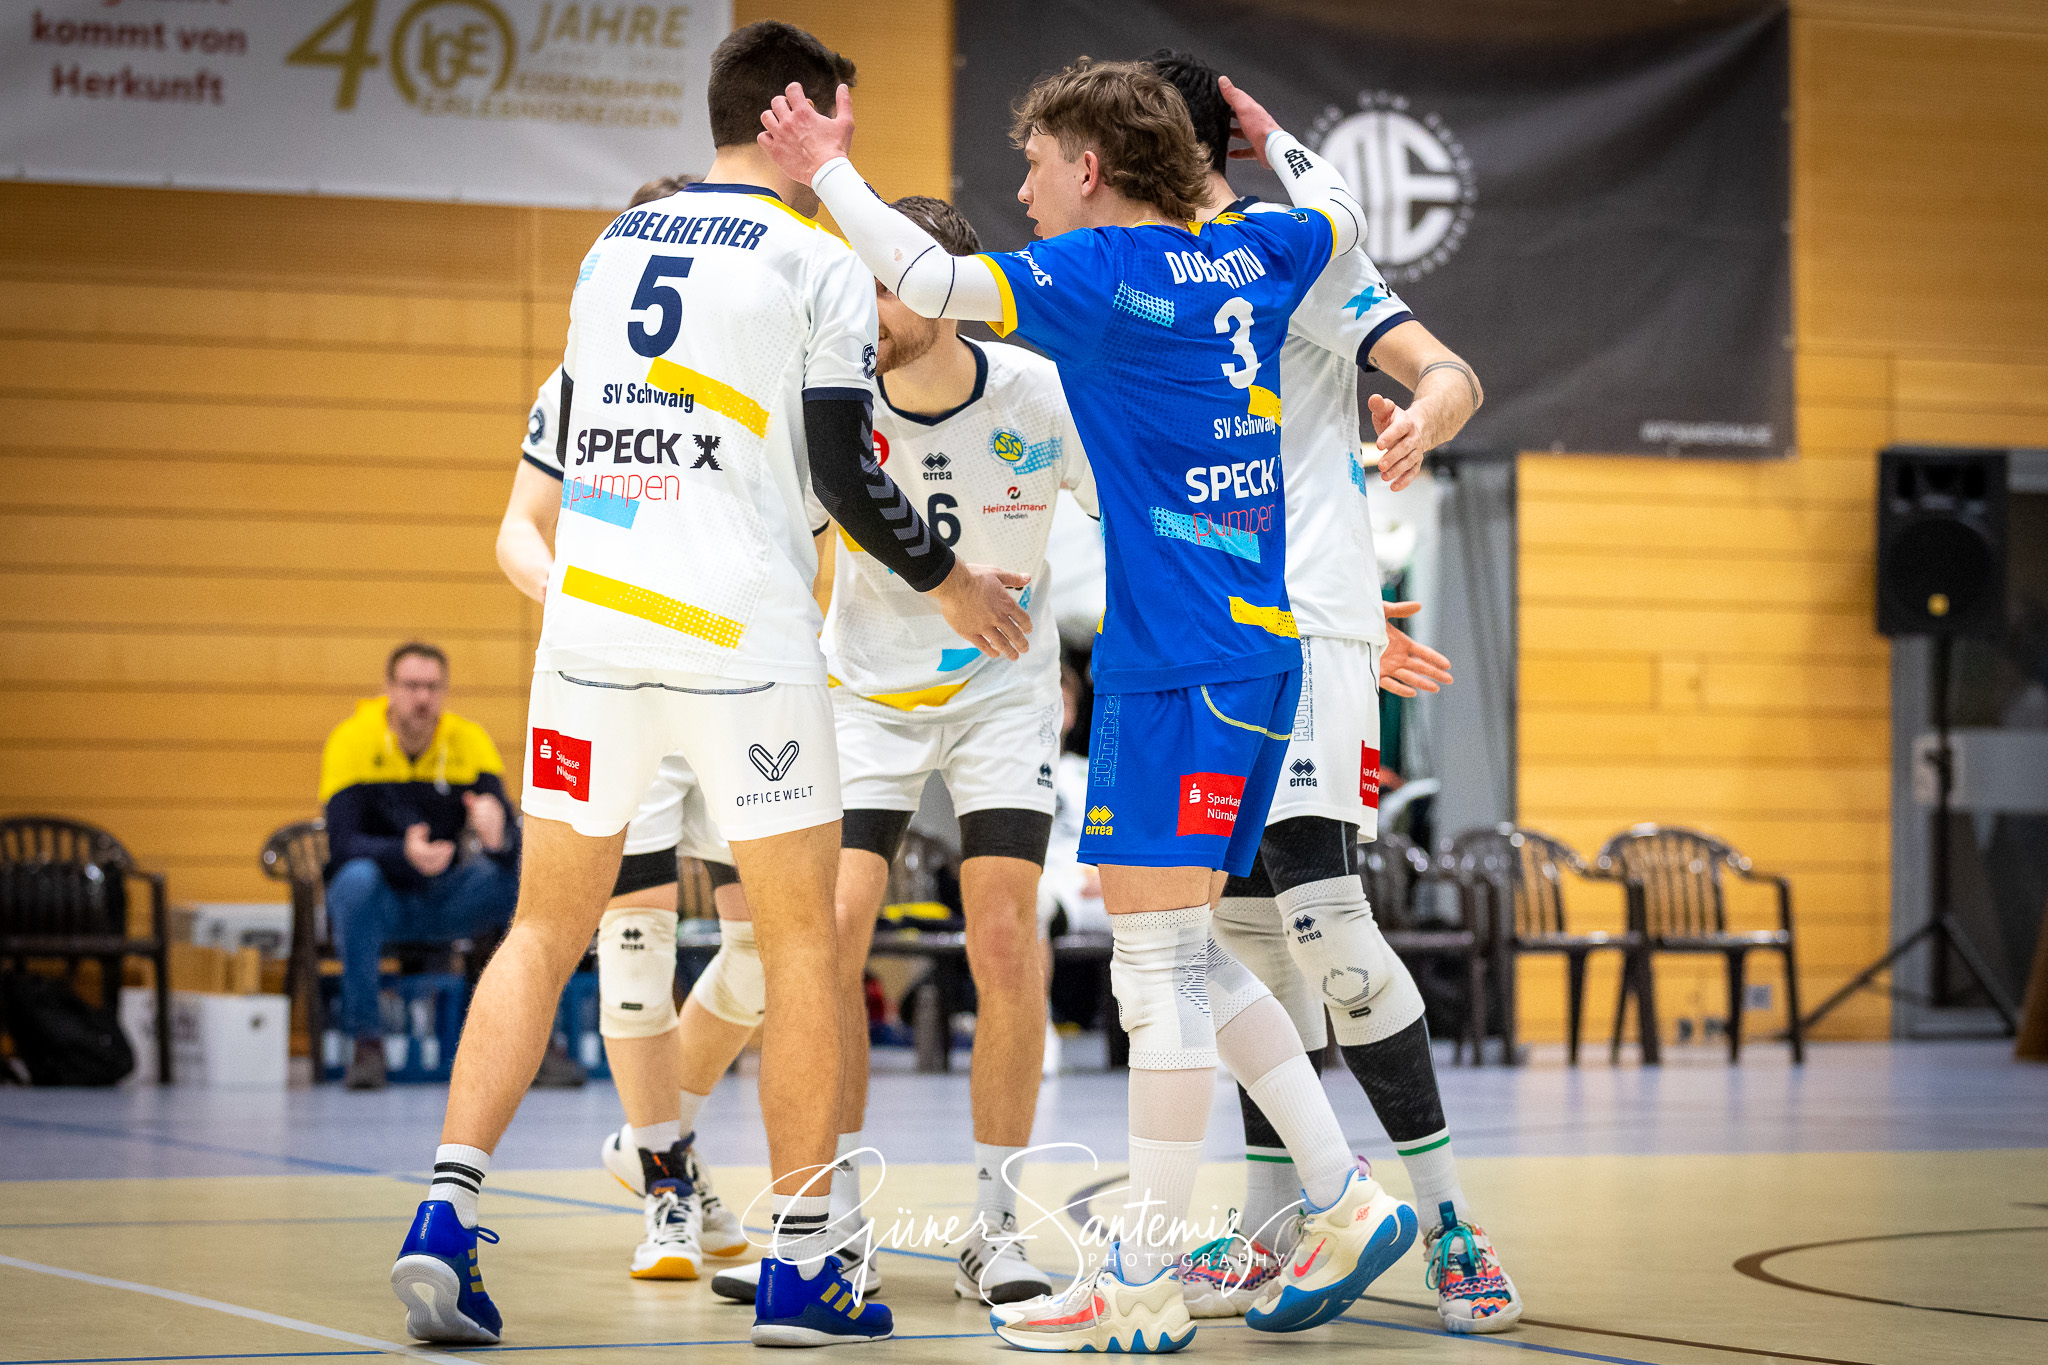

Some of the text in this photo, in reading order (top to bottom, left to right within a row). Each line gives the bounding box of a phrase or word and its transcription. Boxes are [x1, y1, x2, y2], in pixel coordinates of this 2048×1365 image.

[32, 9, 248, 55] kommt von
[528, 3, 690, 53] JAHRE
[53, 63, 225, 106] Herkunft
[604, 211, 768, 250] BIBELRIETHER
[1164, 244, 1267, 289] DOBRTIN
[627, 254, 694, 358] 5
[1213, 297, 1262, 389] 3
[602, 383, 694, 414] SV Schwaig
[575, 428, 682, 466] SPECK
[1213, 417, 1231, 440] SV
[570, 474, 680, 510] pumpen
[923, 470, 952, 481] errea
[1185, 457, 1275, 503] SPECK
[927, 493, 962, 548] 6
[983, 502, 1048, 514] Heinzelmann
[1003, 512, 1028, 520] Medien
[1092, 694, 1117, 787] HÜTTING
[736, 786, 813, 807] OFFICEWELT
[1289, 776, 1317, 788] errea
[1086, 824, 1113, 836] errea
[1297, 929, 1322, 944] errea
